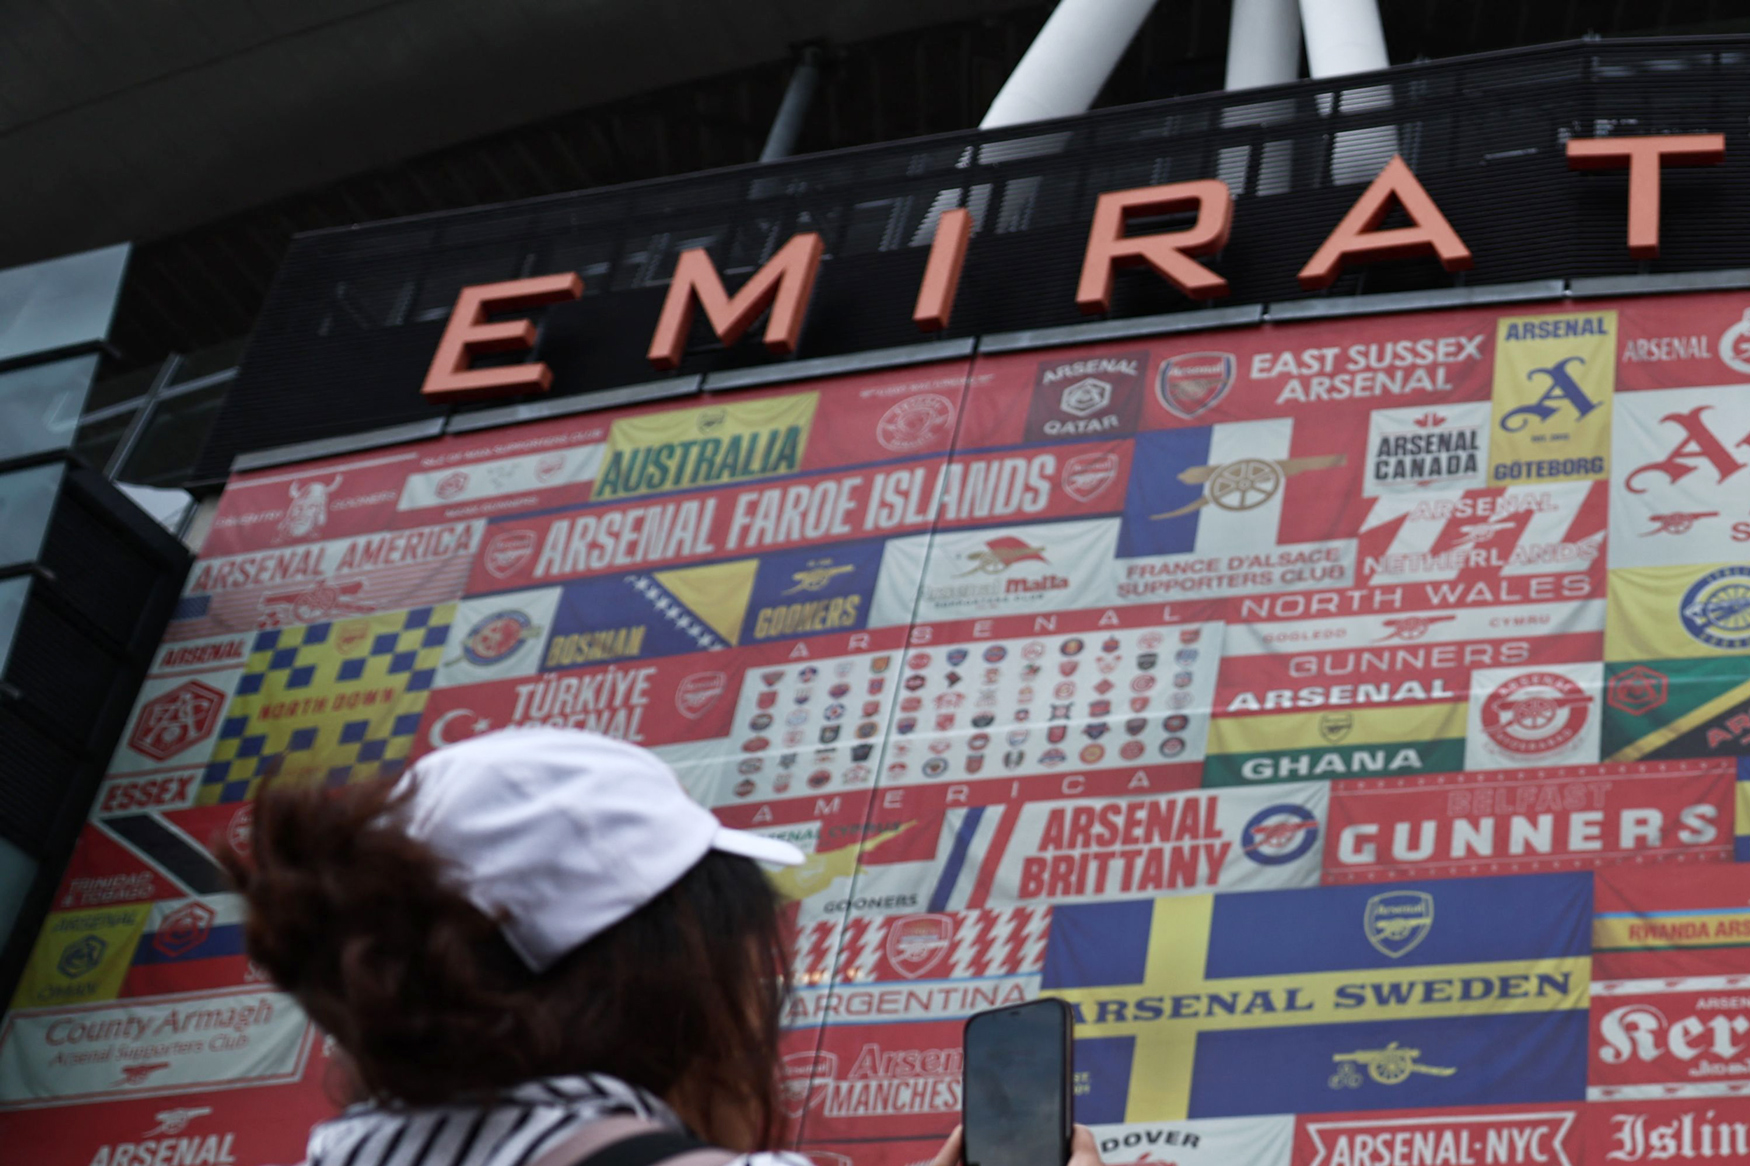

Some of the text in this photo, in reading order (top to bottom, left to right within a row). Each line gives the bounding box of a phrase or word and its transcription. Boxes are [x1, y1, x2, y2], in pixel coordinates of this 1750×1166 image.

[1504, 317, 1608, 342] ARSENAL
[1249, 334, 1484, 380] EAST SUSSEX
[1623, 335, 1711, 362] ARSENAL
[1042, 357, 1139, 385] ARSENAL
[1275, 367, 1453, 404] ARSENAL
[1043, 414, 1119, 436] QATAR
[1376, 431, 1479, 458] ARSENAL
[599, 426, 801, 498] AUSTRALIA
[1374, 452, 1479, 480] CANADA
[1493, 456, 1605, 481] GÖTEBORG
[532, 454, 1057, 579] ARSENAL FAROE ISLANDS
[190, 523, 472, 592] ARSENAL AMERICA
[1127, 547, 1340, 578] FRANCE D'ALSACE
[1363, 544, 1600, 576] NETHERLANDS
[1118, 564, 1345, 597] SUPPORTERS CLUB
[1241, 577, 1591, 619] NORTH WALES
[160, 639, 245, 668] ARSENAL
[1289, 643, 1529, 676] GUNNERS
[1226, 679, 1454, 712] ARSENAL
[1241, 749, 1422, 780] GHANA
[102, 772, 197, 812] ESSEX
[1447, 783, 1612, 816] BELFAST
[1038, 796, 1223, 852] ARSENAL
[1337, 803, 1719, 866] GUNNERS
[1019, 842, 1230, 900] BRITTANY
[824, 894, 918, 914] GOONERS
[1629, 918, 1709, 942] RWANDA
[785, 983, 1027, 1019] ARGENTINA
[1073, 974, 1573, 1026] ARSENAL SWEDEN
[45, 1000, 273, 1048] County Armagh
[1102, 1130, 1201, 1153] DOVER
